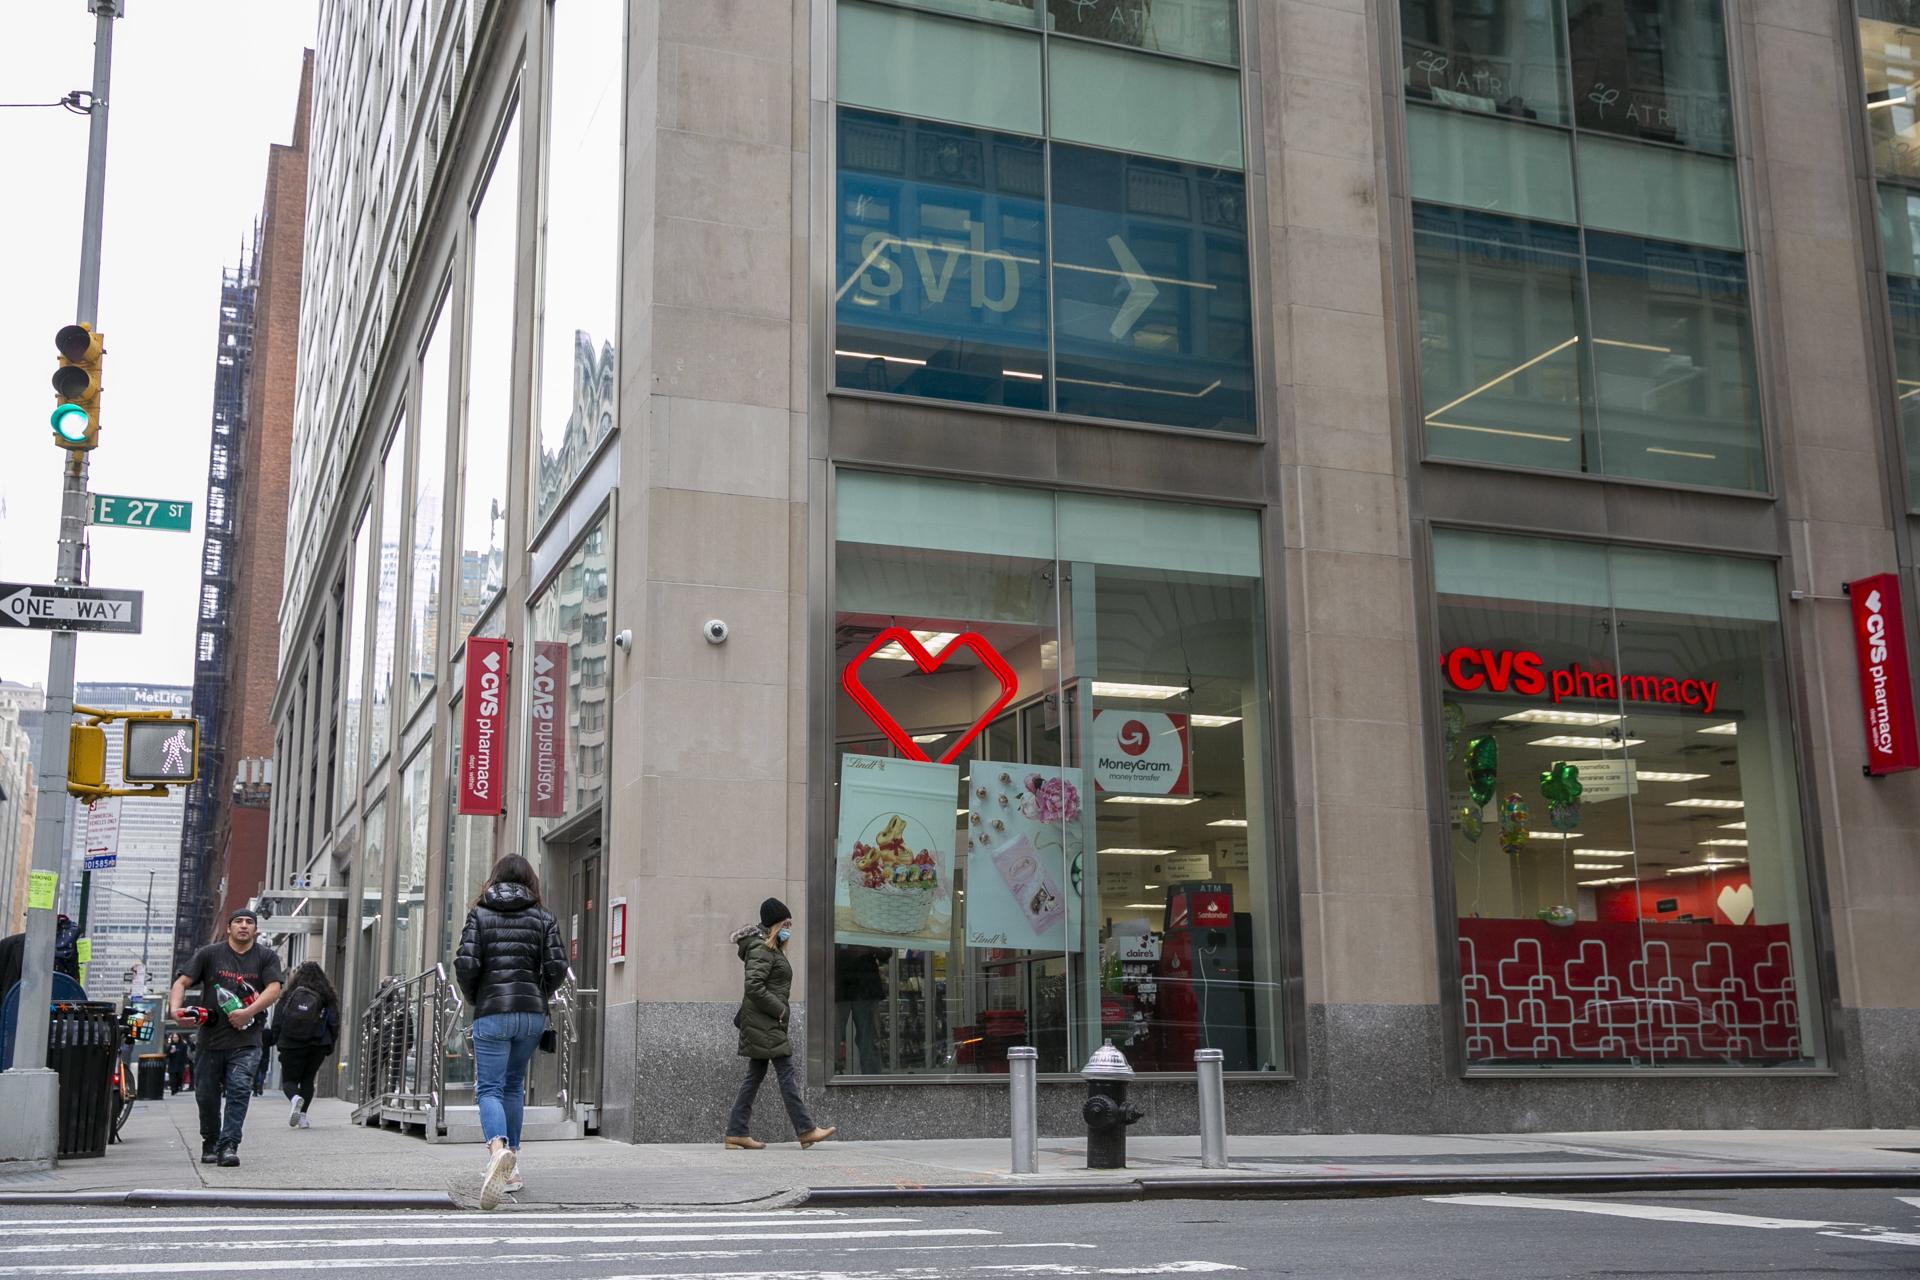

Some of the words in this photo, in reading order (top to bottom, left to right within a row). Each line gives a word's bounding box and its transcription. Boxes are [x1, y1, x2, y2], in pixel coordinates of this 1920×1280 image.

[860, 222, 1020, 313] svb
[99, 497, 115, 523] E
[127, 501, 159, 526] 27
[169, 503, 184, 517] ST
[11, 597, 54, 616] ONE
[76, 601, 122, 620] WAY
[1866, 613, 1888, 664] CVS
[1448, 647, 1546, 694] CVS
[1551, 662, 1719, 715] pharmacy
[134, 691, 183, 704] MetLife
[480, 672, 500, 717] CVS
[1869, 665, 1893, 754] pharmacy
[473, 718, 495, 800] pharmacy
[845, 757, 877, 771] Lindt
[1098, 757, 1171, 773] MoneyGram
[1109, 773, 1132, 783] money
[1133, 774, 1160, 782] transfer
[1200, 884, 1222, 892] ATM
[970, 931, 1000, 945] Lindt
[1126, 949, 1154, 958] claire's
